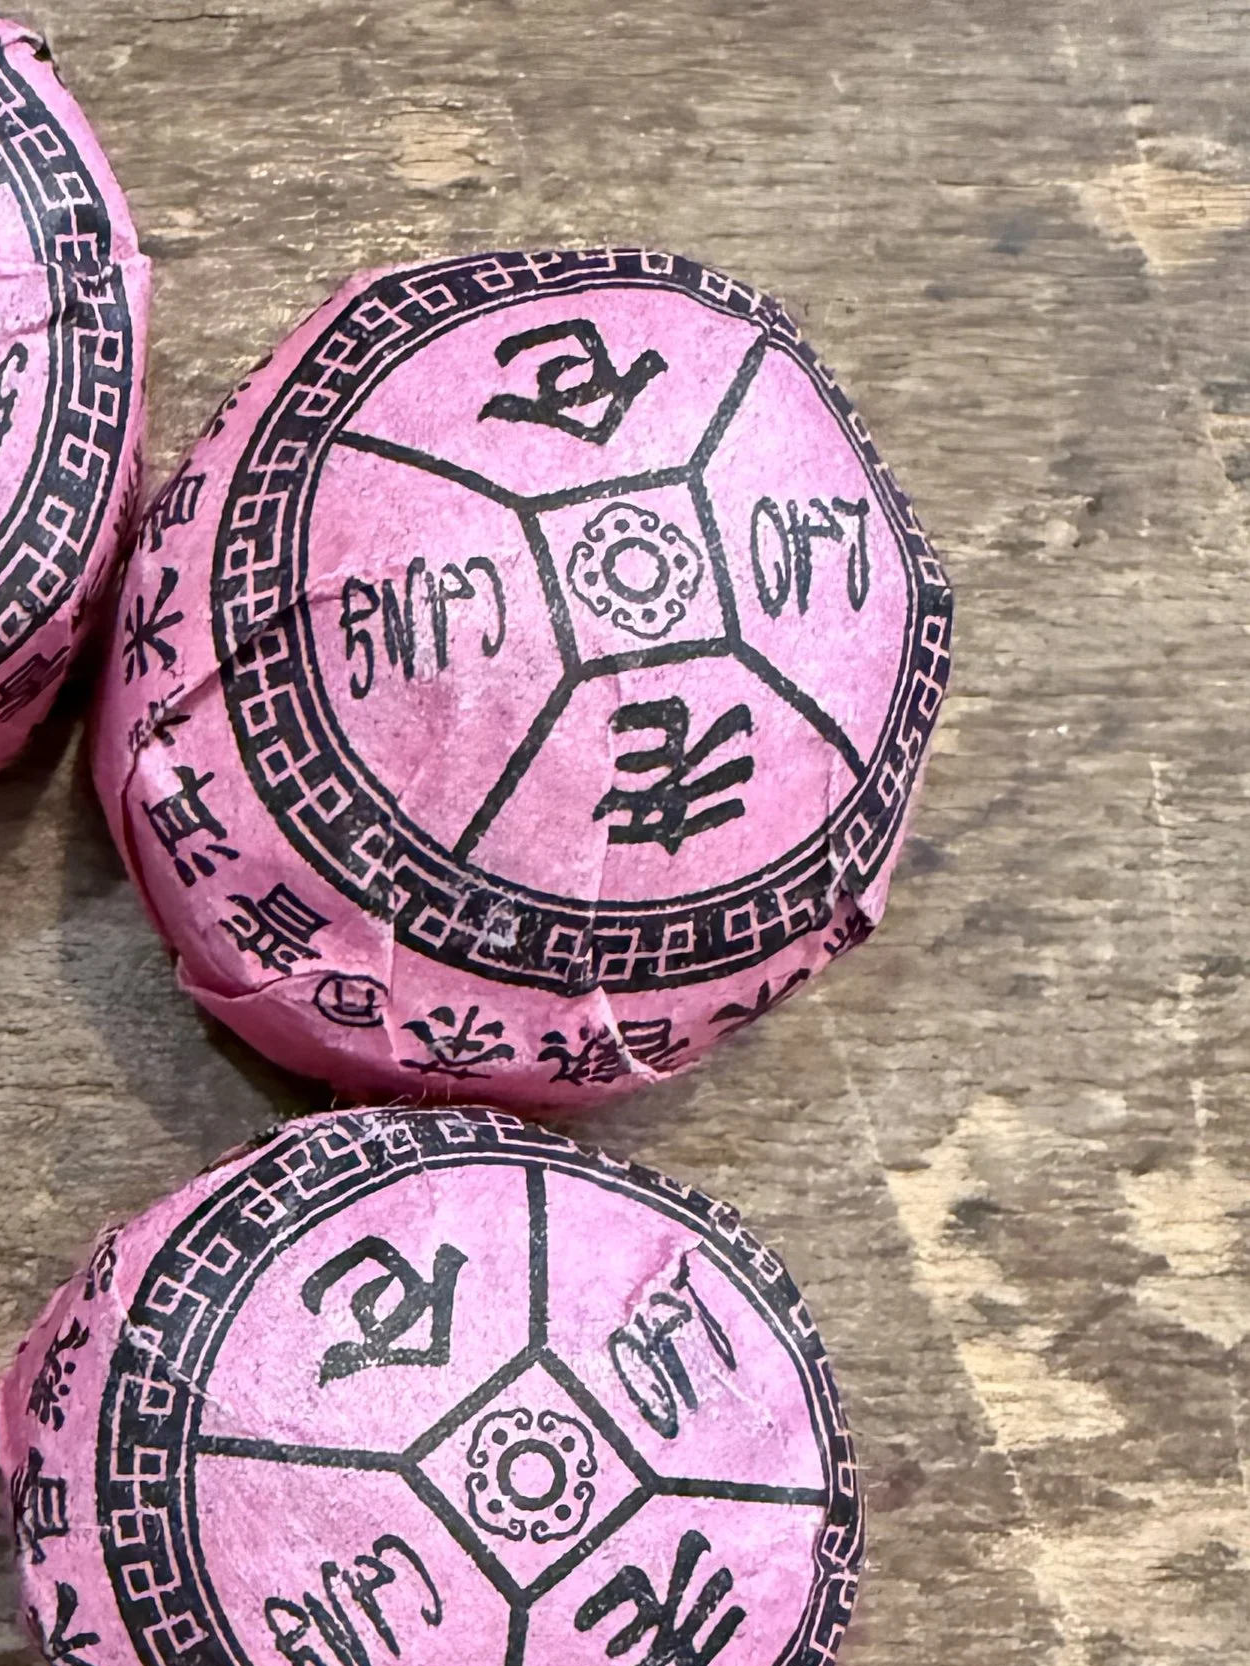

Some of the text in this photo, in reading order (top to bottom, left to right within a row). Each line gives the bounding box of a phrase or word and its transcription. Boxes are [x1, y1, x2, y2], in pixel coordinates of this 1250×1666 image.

[477, 319, 668, 446] 仓
[342, 556, 507, 699] CANG
[749, 495, 871, 619] LAO
[592, 695, 754, 855] 老
[300, 1235, 469, 1389] 仓
[607, 1256, 738, 1440] LAO
